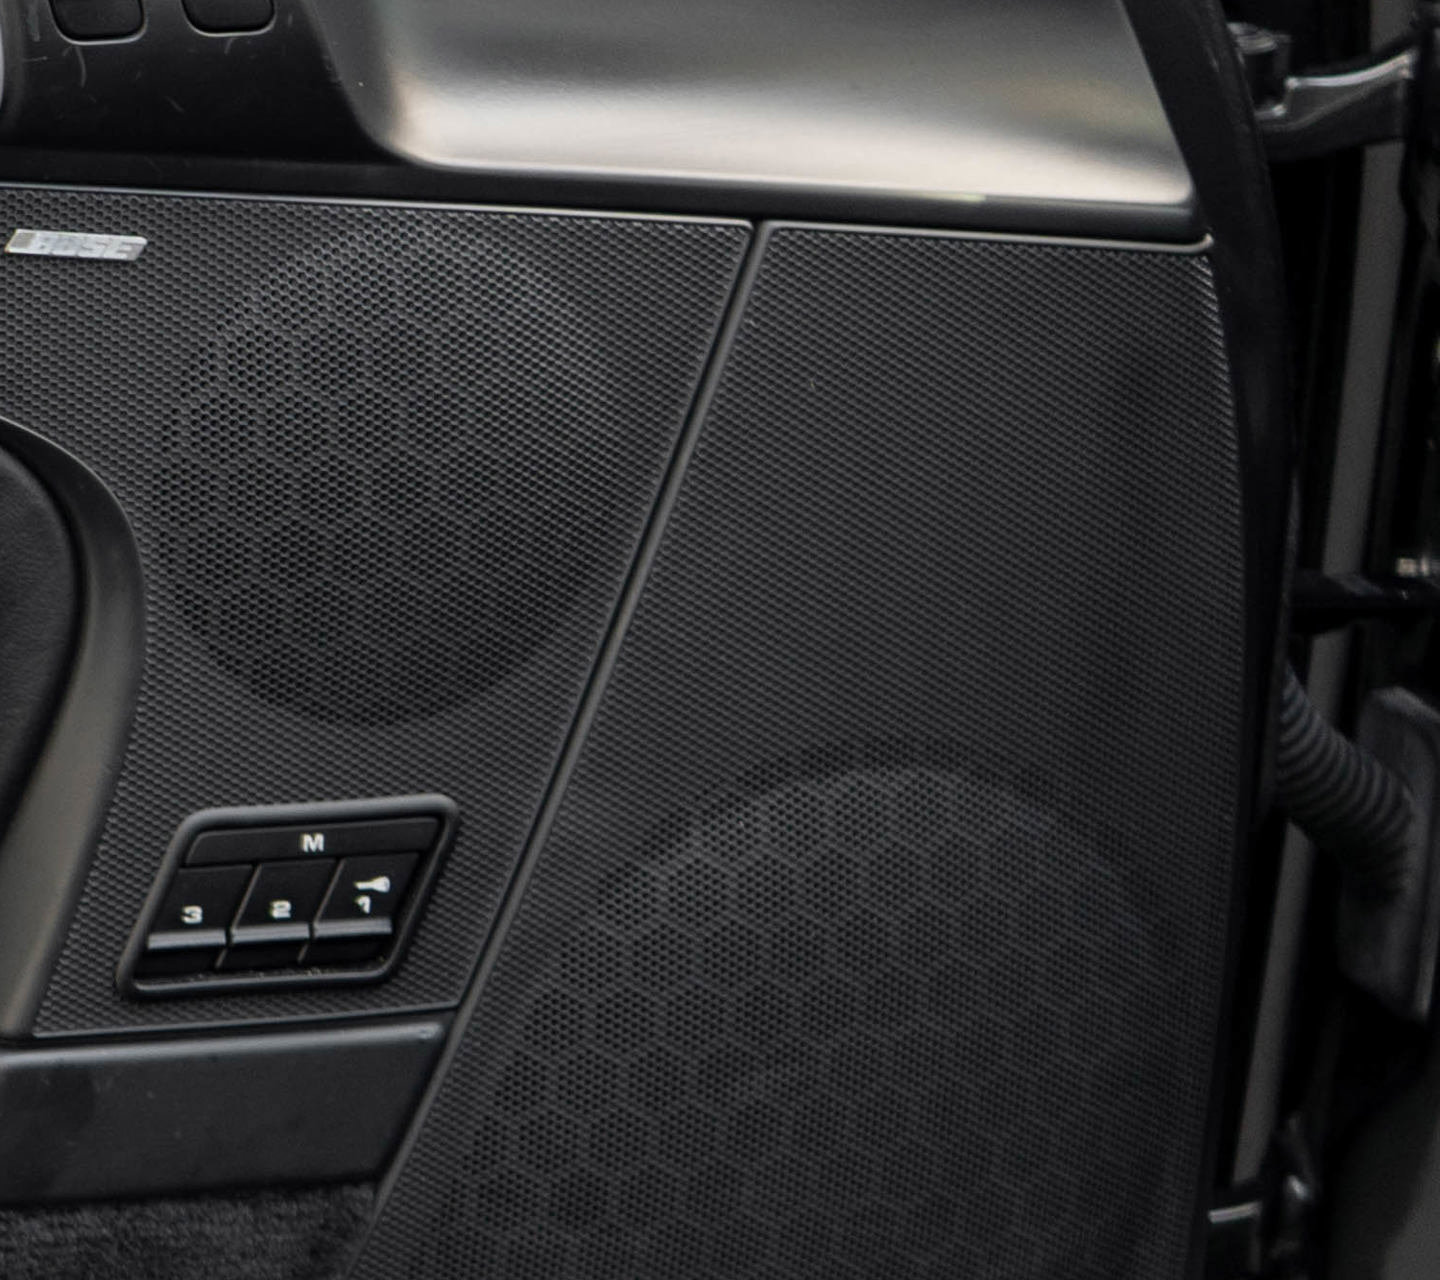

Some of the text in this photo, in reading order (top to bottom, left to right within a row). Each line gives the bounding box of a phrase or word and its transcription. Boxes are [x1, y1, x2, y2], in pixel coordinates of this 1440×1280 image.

[301, 834, 325, 852] M
[269, 900, 292, 919] 2
[355, 896, 373, 914] 1
[181, 905, 203, 925] 3
